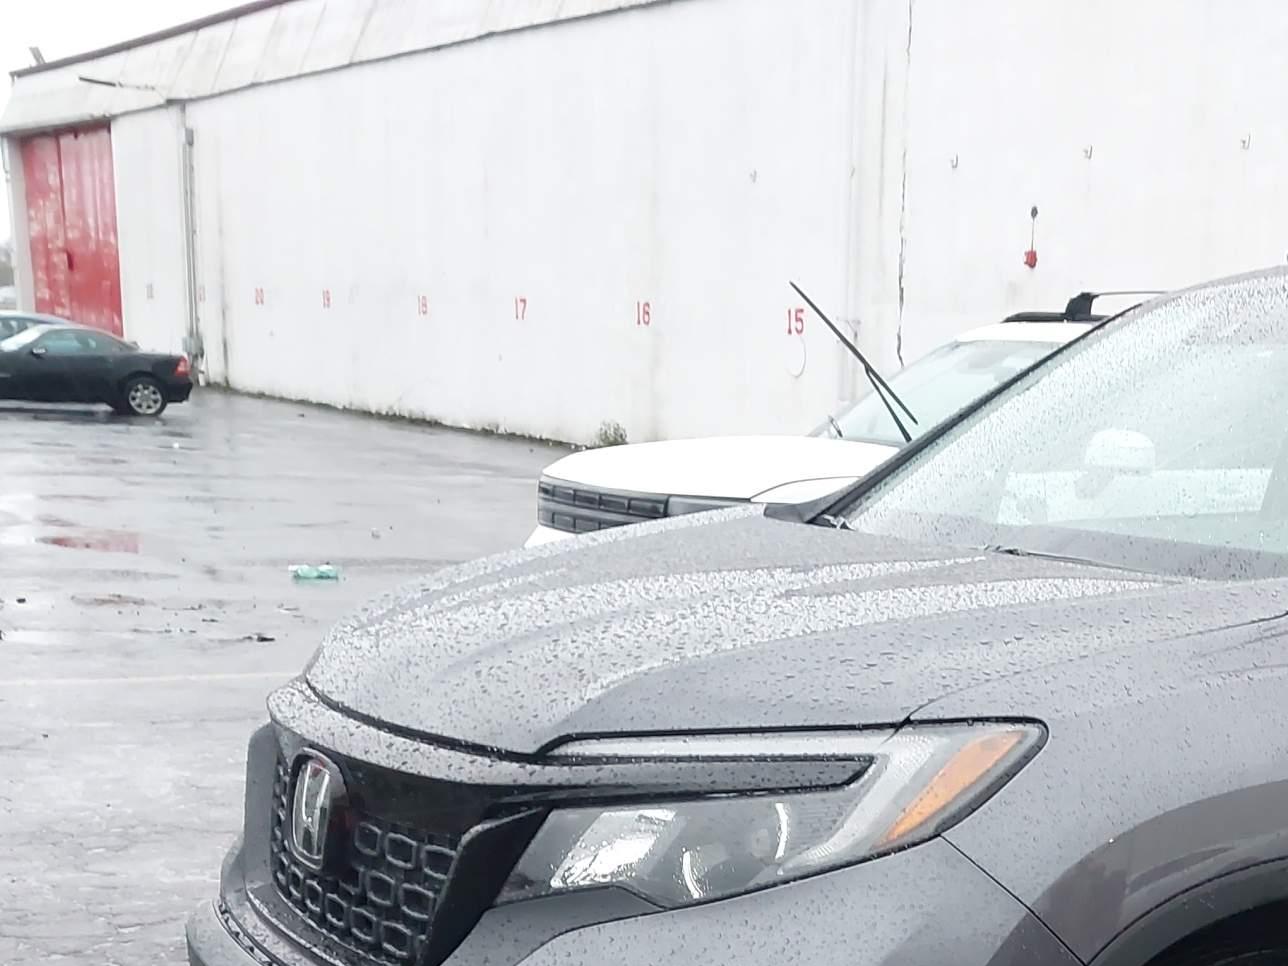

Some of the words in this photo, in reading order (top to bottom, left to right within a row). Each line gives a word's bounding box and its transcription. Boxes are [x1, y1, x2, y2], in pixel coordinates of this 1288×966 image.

[515, 298, 527, 320] 17
[636, 301, 651, 325] 16
[787, 308, 804, 335] 15
